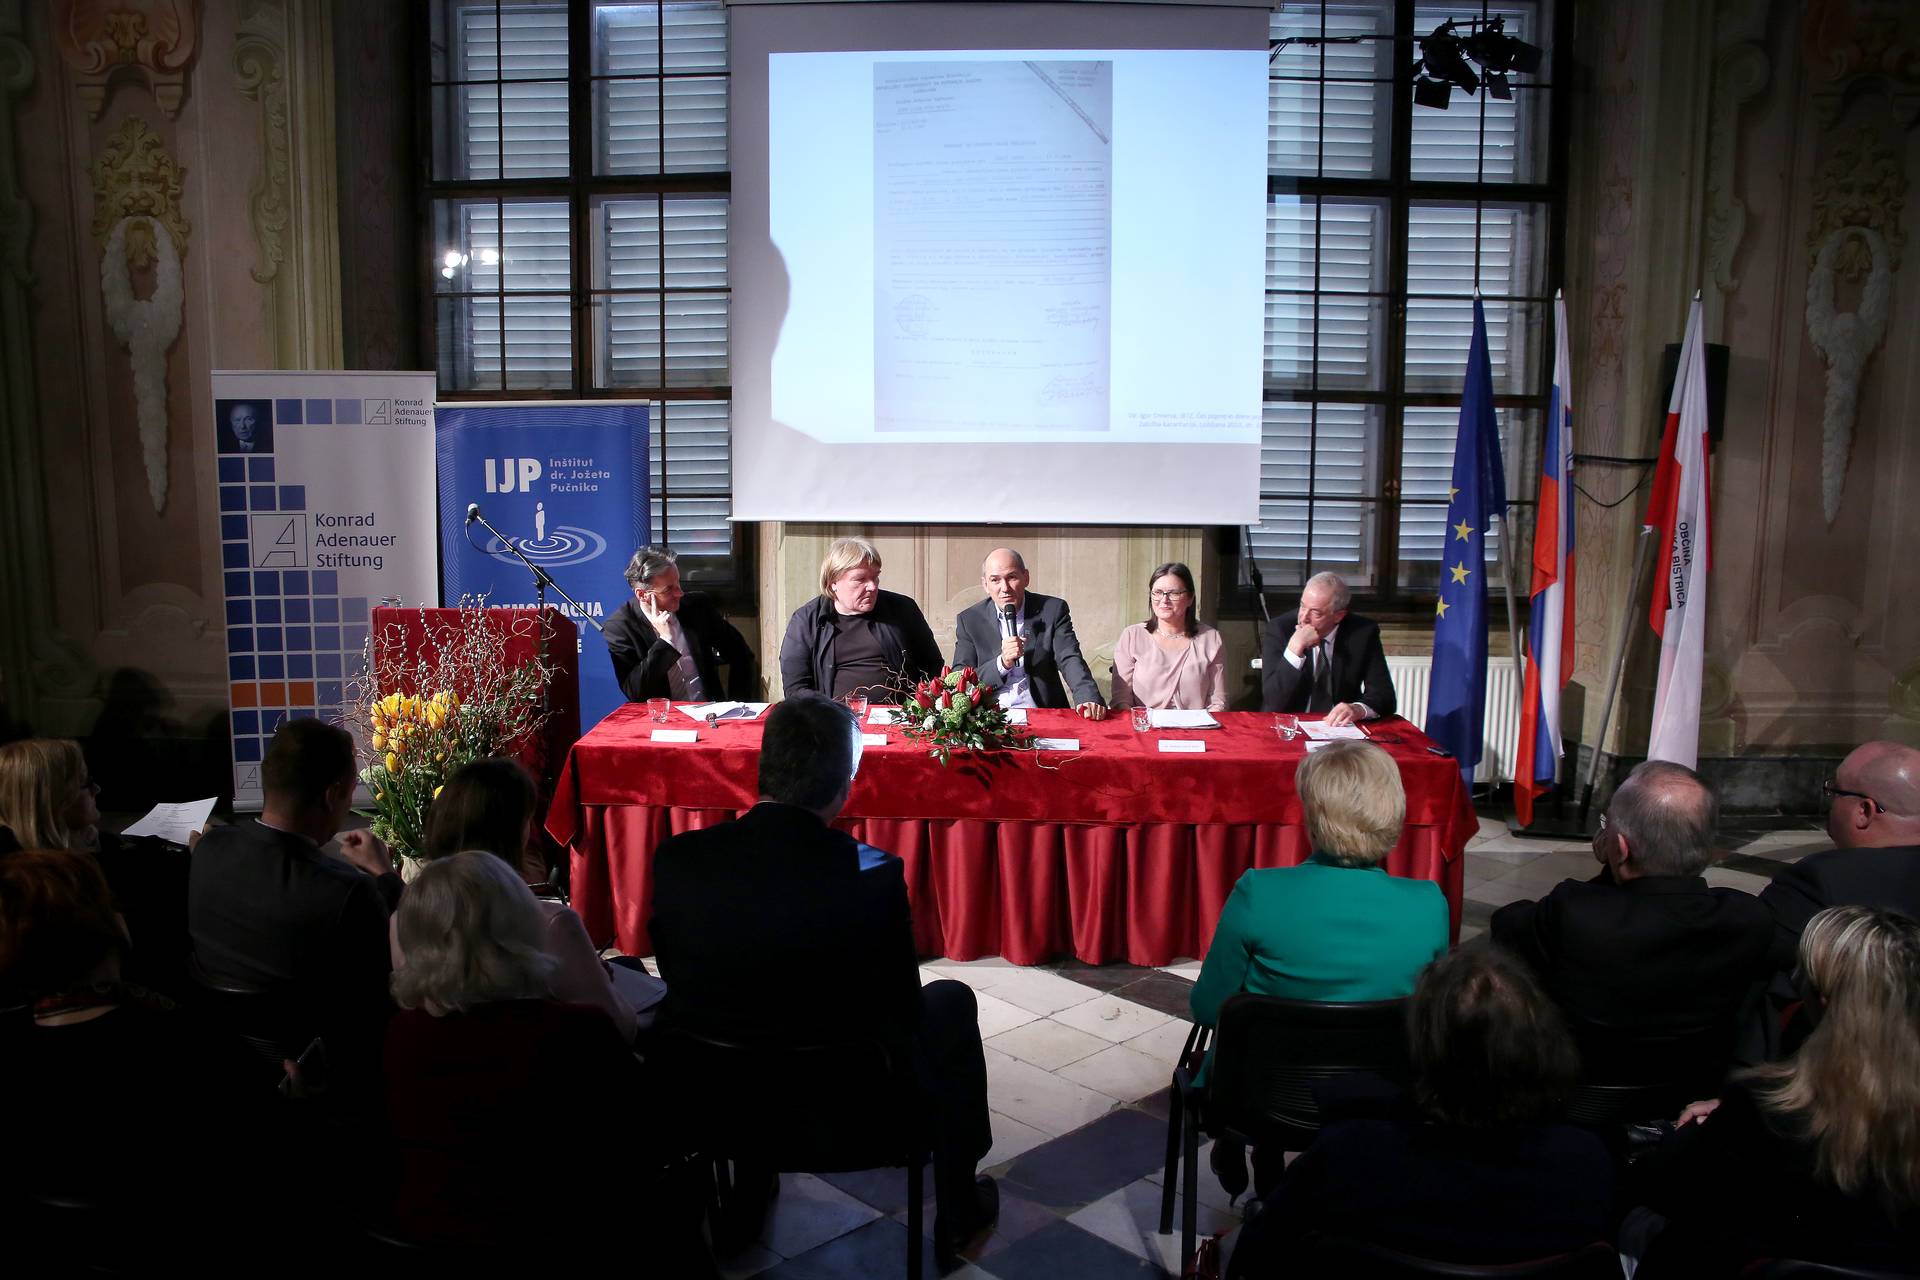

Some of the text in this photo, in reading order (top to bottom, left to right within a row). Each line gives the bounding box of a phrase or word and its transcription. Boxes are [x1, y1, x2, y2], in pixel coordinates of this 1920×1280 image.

[394, 408, 432, 416] Adenauer
[394, 417, 427, 427] Stiftung
[549, 458, 593, 468] Inštitut
[485, 458, 542, 493] IJP
[550, 470, 610, 480] dr. Jožeta
[550, 482, 599, 492] Pučnika
[315, 512, 375, 527] Konrad
[315, 533, 397, 547] Adenauer
[1679, 522, 1690, 566] OBČINA
[316, 553, 384, 570] Stiftung
[1672, 555, 1686, 609] BISTRICA
